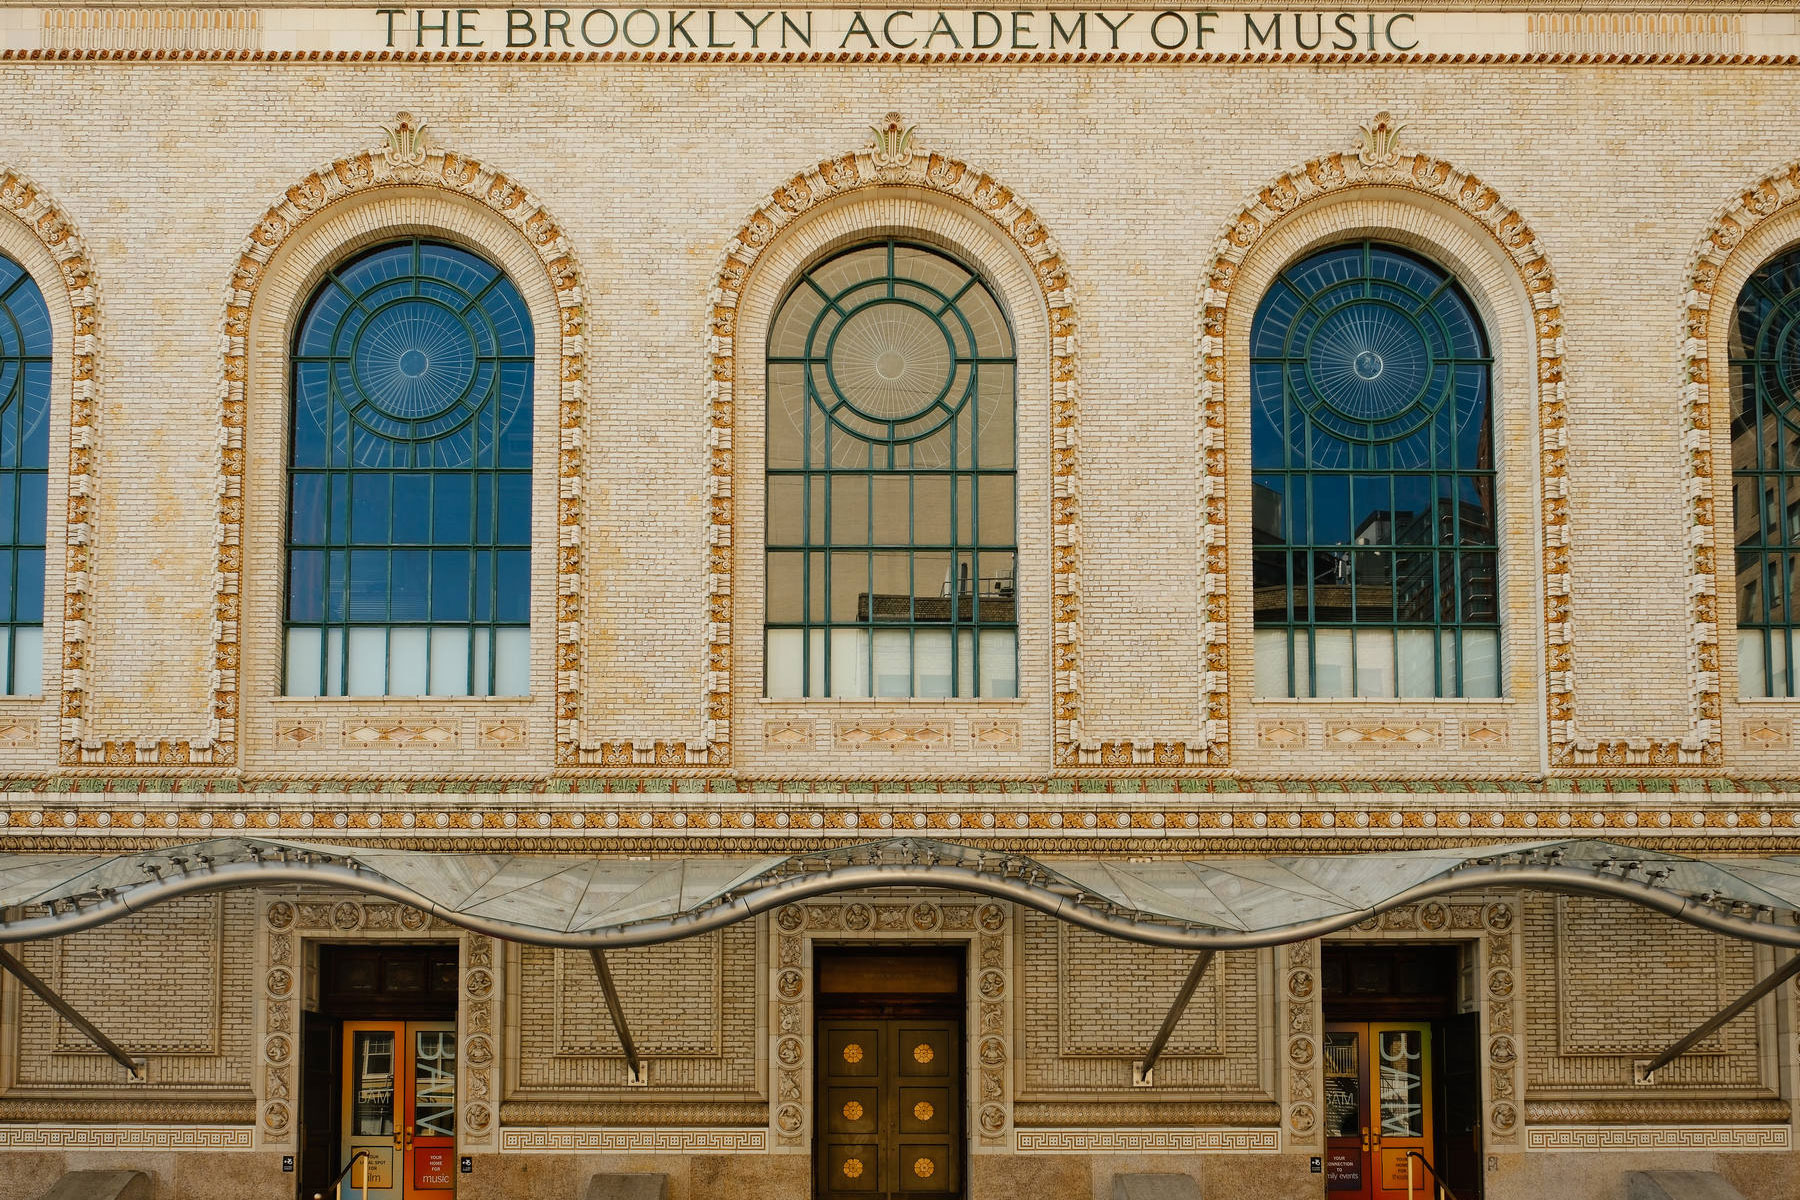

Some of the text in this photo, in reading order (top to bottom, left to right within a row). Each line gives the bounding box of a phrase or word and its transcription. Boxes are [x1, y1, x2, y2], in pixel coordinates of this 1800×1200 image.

[376, 9, 1419, 51] THE BROOKLYN ACADEMY OF MUSIC
[358, 1090, 390, 1104] BAM
[367, 1173, 381, 1183] ilm
[422, 1173, 450, 1184] music
